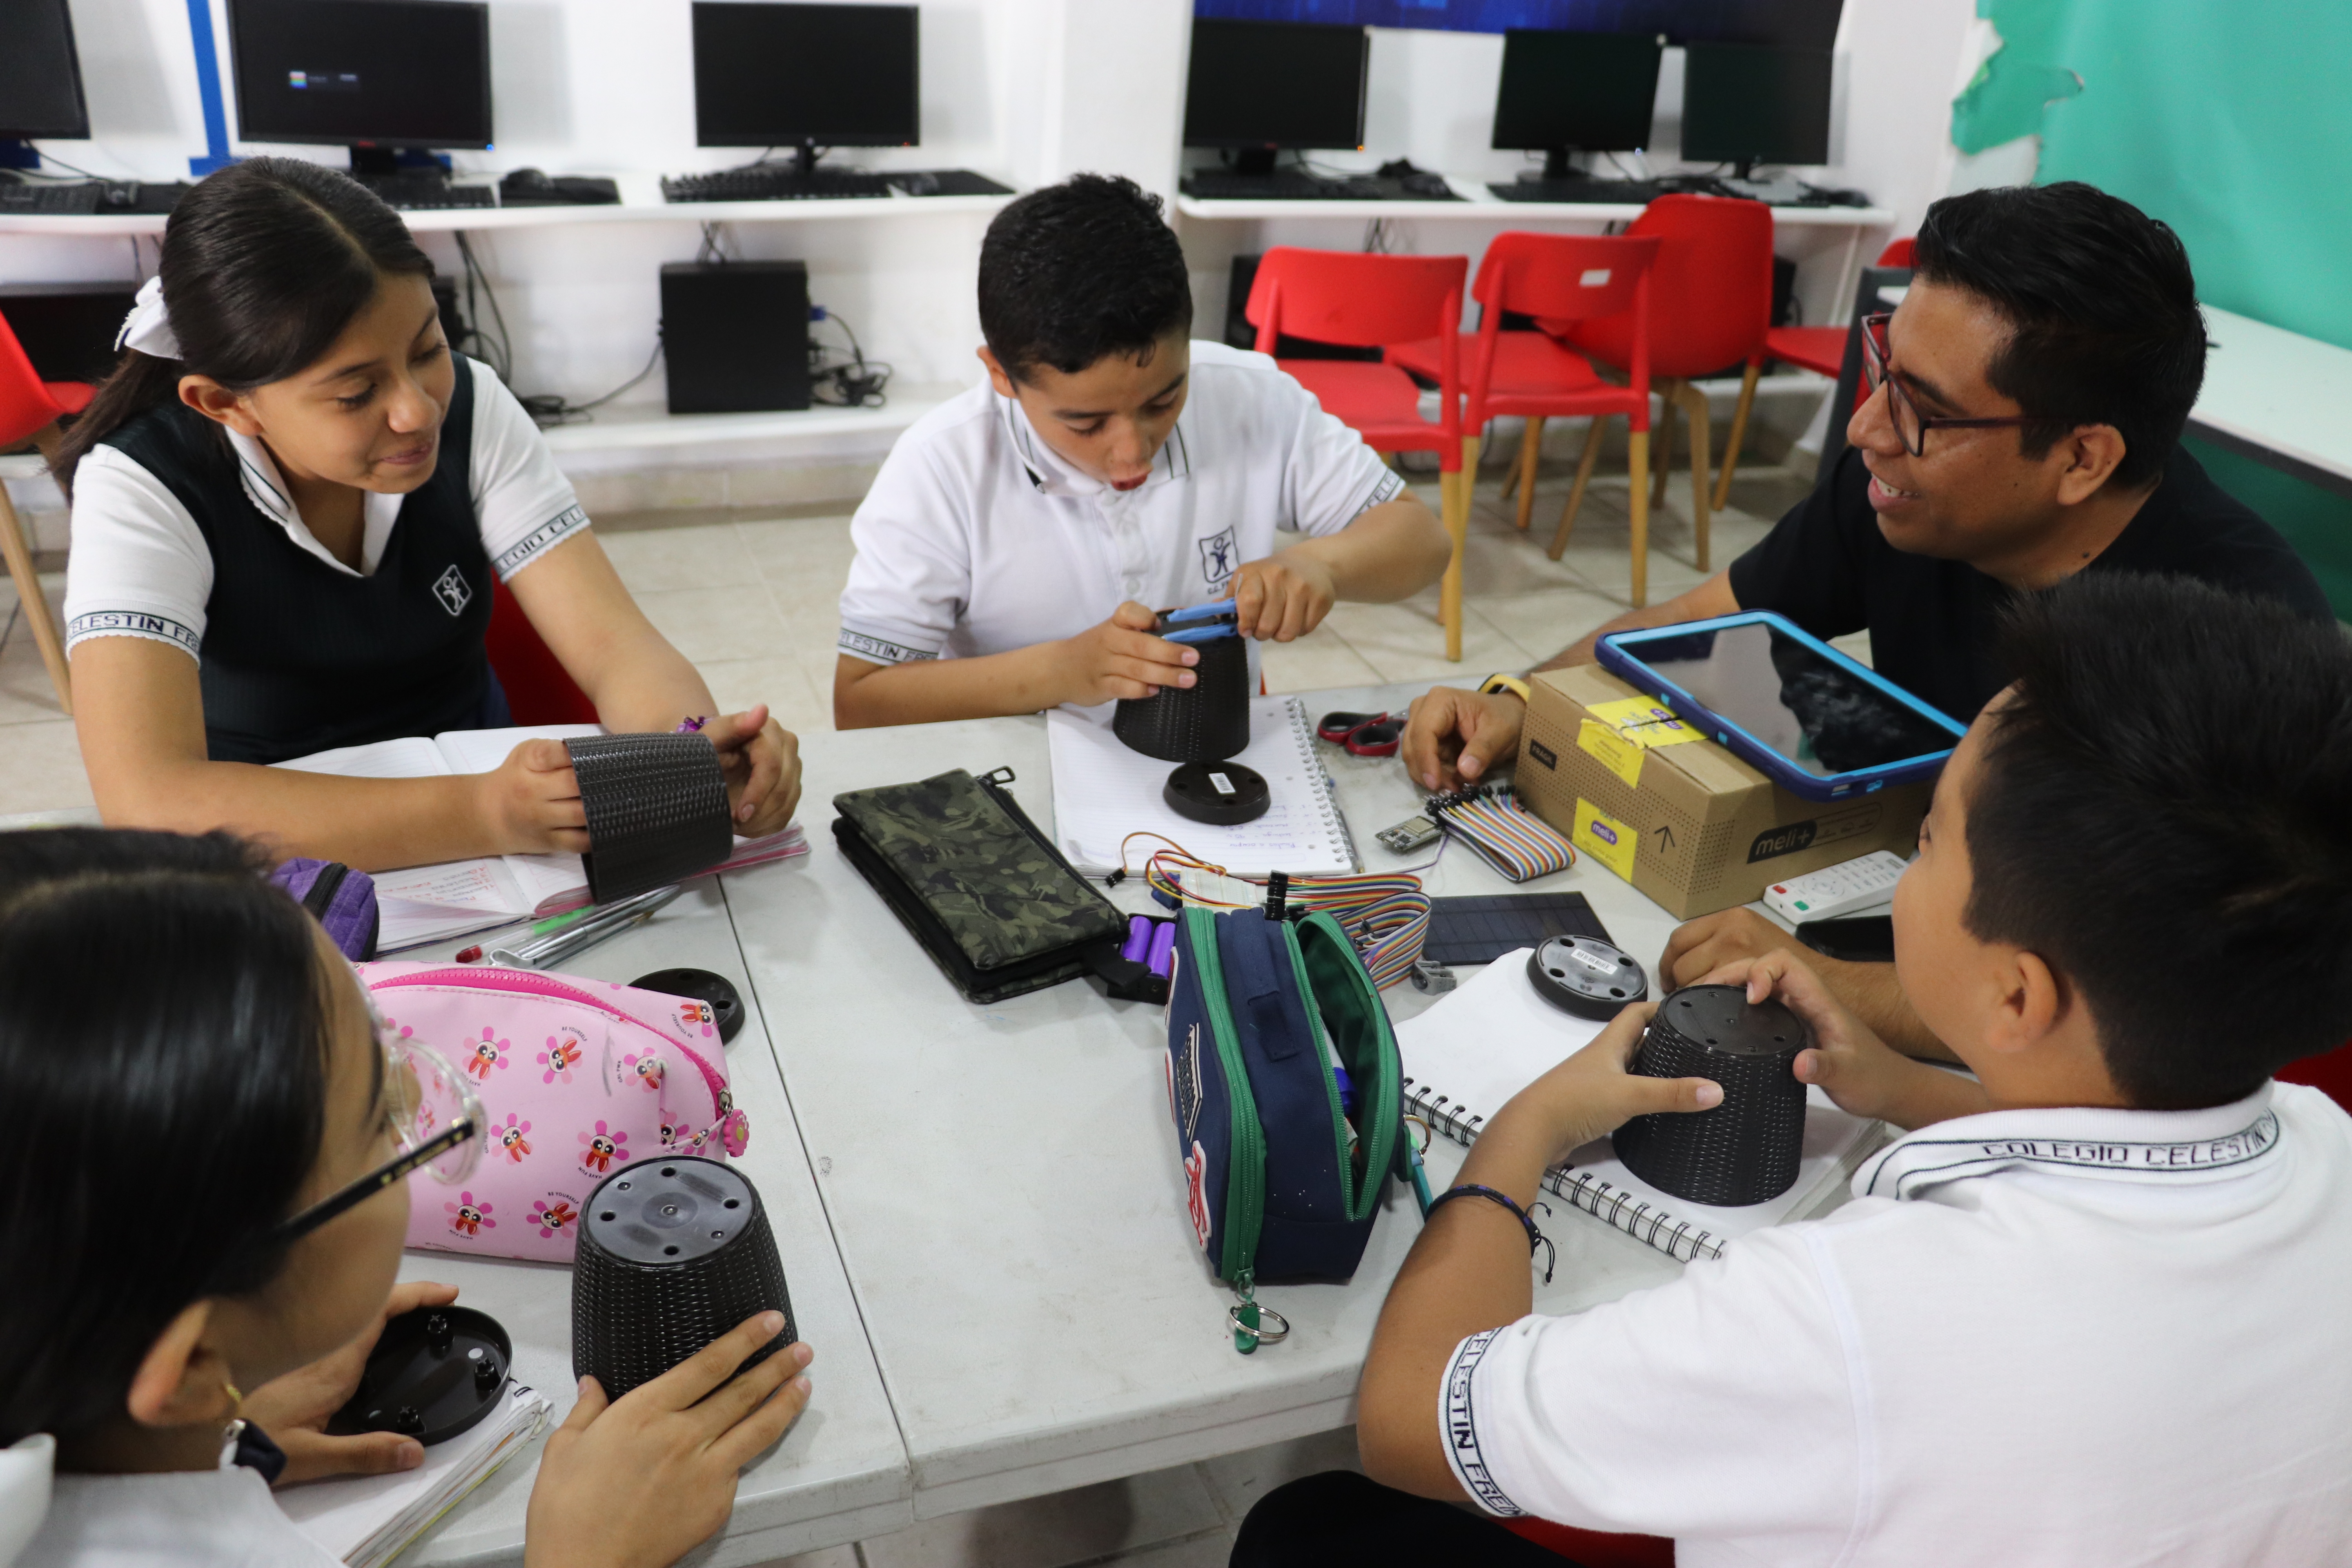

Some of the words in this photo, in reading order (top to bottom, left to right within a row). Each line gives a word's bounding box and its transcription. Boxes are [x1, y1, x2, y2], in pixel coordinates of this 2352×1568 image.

[1755, 828, 1810, 855] meli+
[671, 1013, 687, 1034] YOURSELF
[569, 1026, 588, 1042] YOURSELF
[1983, 1142, 2127, 1165] COLEGIO
[2146, 1127, 2268, 1165] CELESTIN
[578, 1167, 588, 1175] FUN
[556, 1192, 579, 1204] YOURSELF
